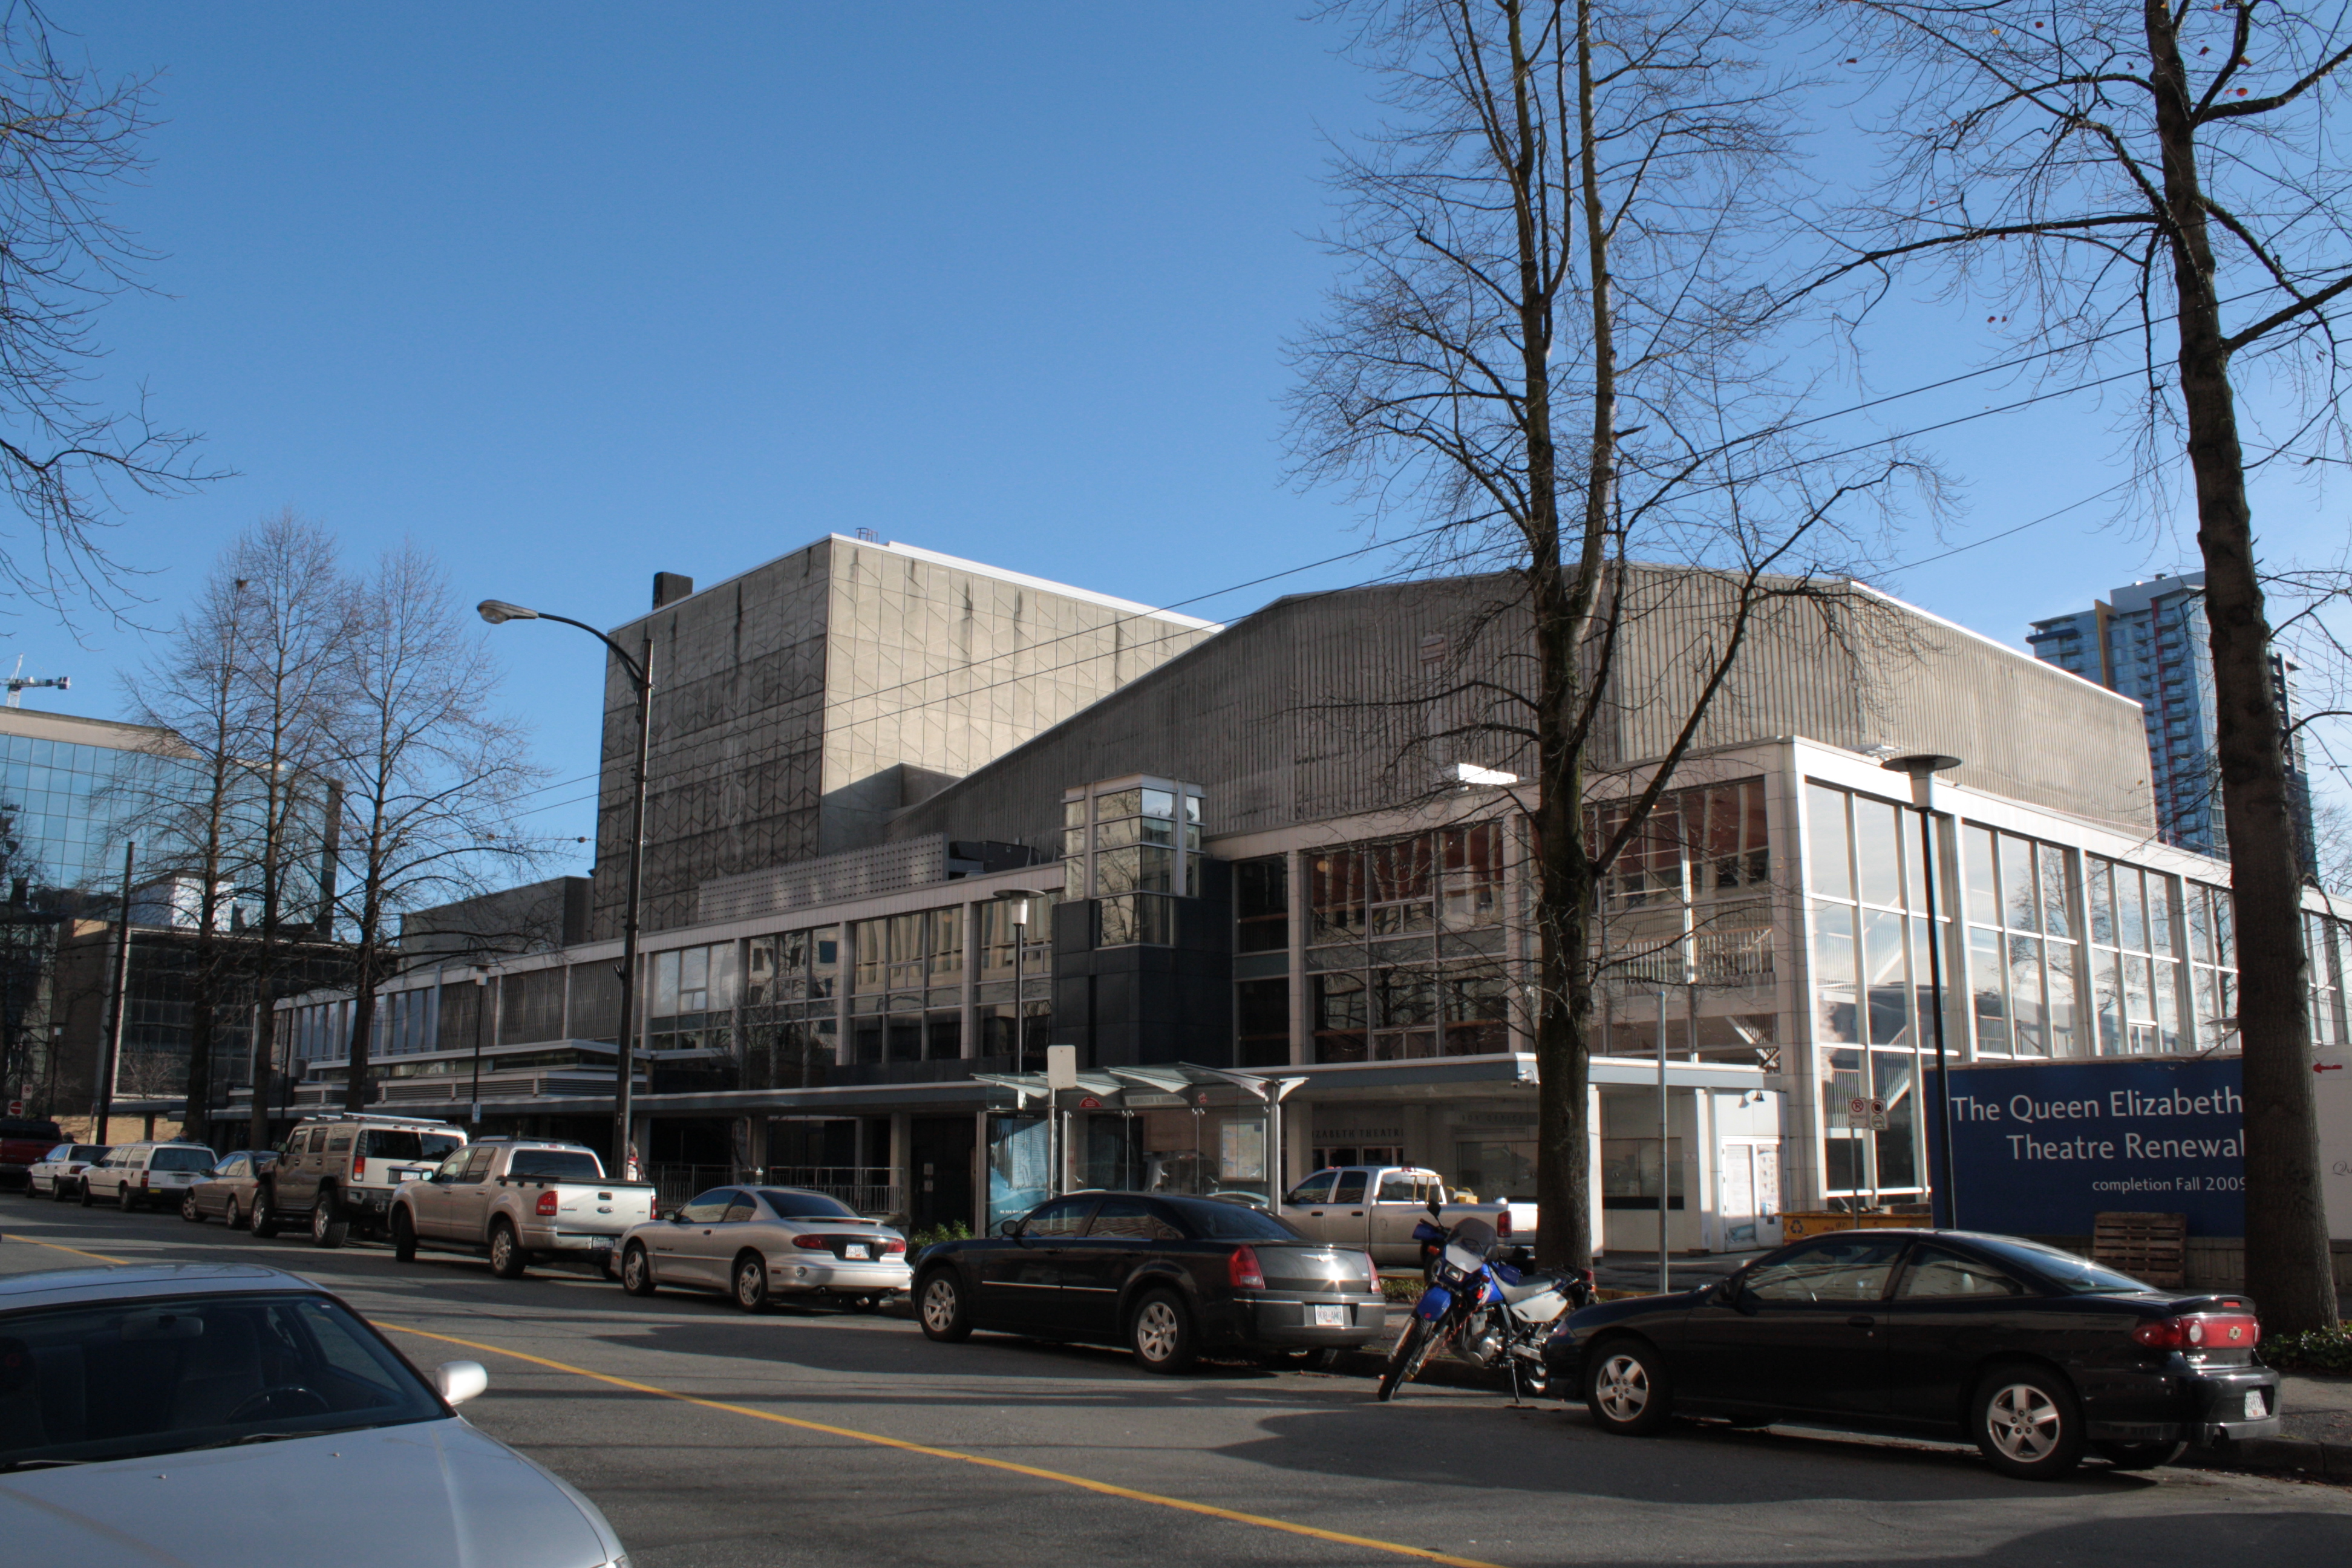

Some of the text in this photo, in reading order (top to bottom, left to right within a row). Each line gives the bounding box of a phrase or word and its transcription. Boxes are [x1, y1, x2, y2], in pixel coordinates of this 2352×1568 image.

[1950, 1086, 2243, 1123] The Queen Elizabeth
[2005, 1129, 2244, 1160] Theatre Renewal
[2092, 1177, 2171, 1194] completion
[2176, 1177, 2200, 1191] Fall
